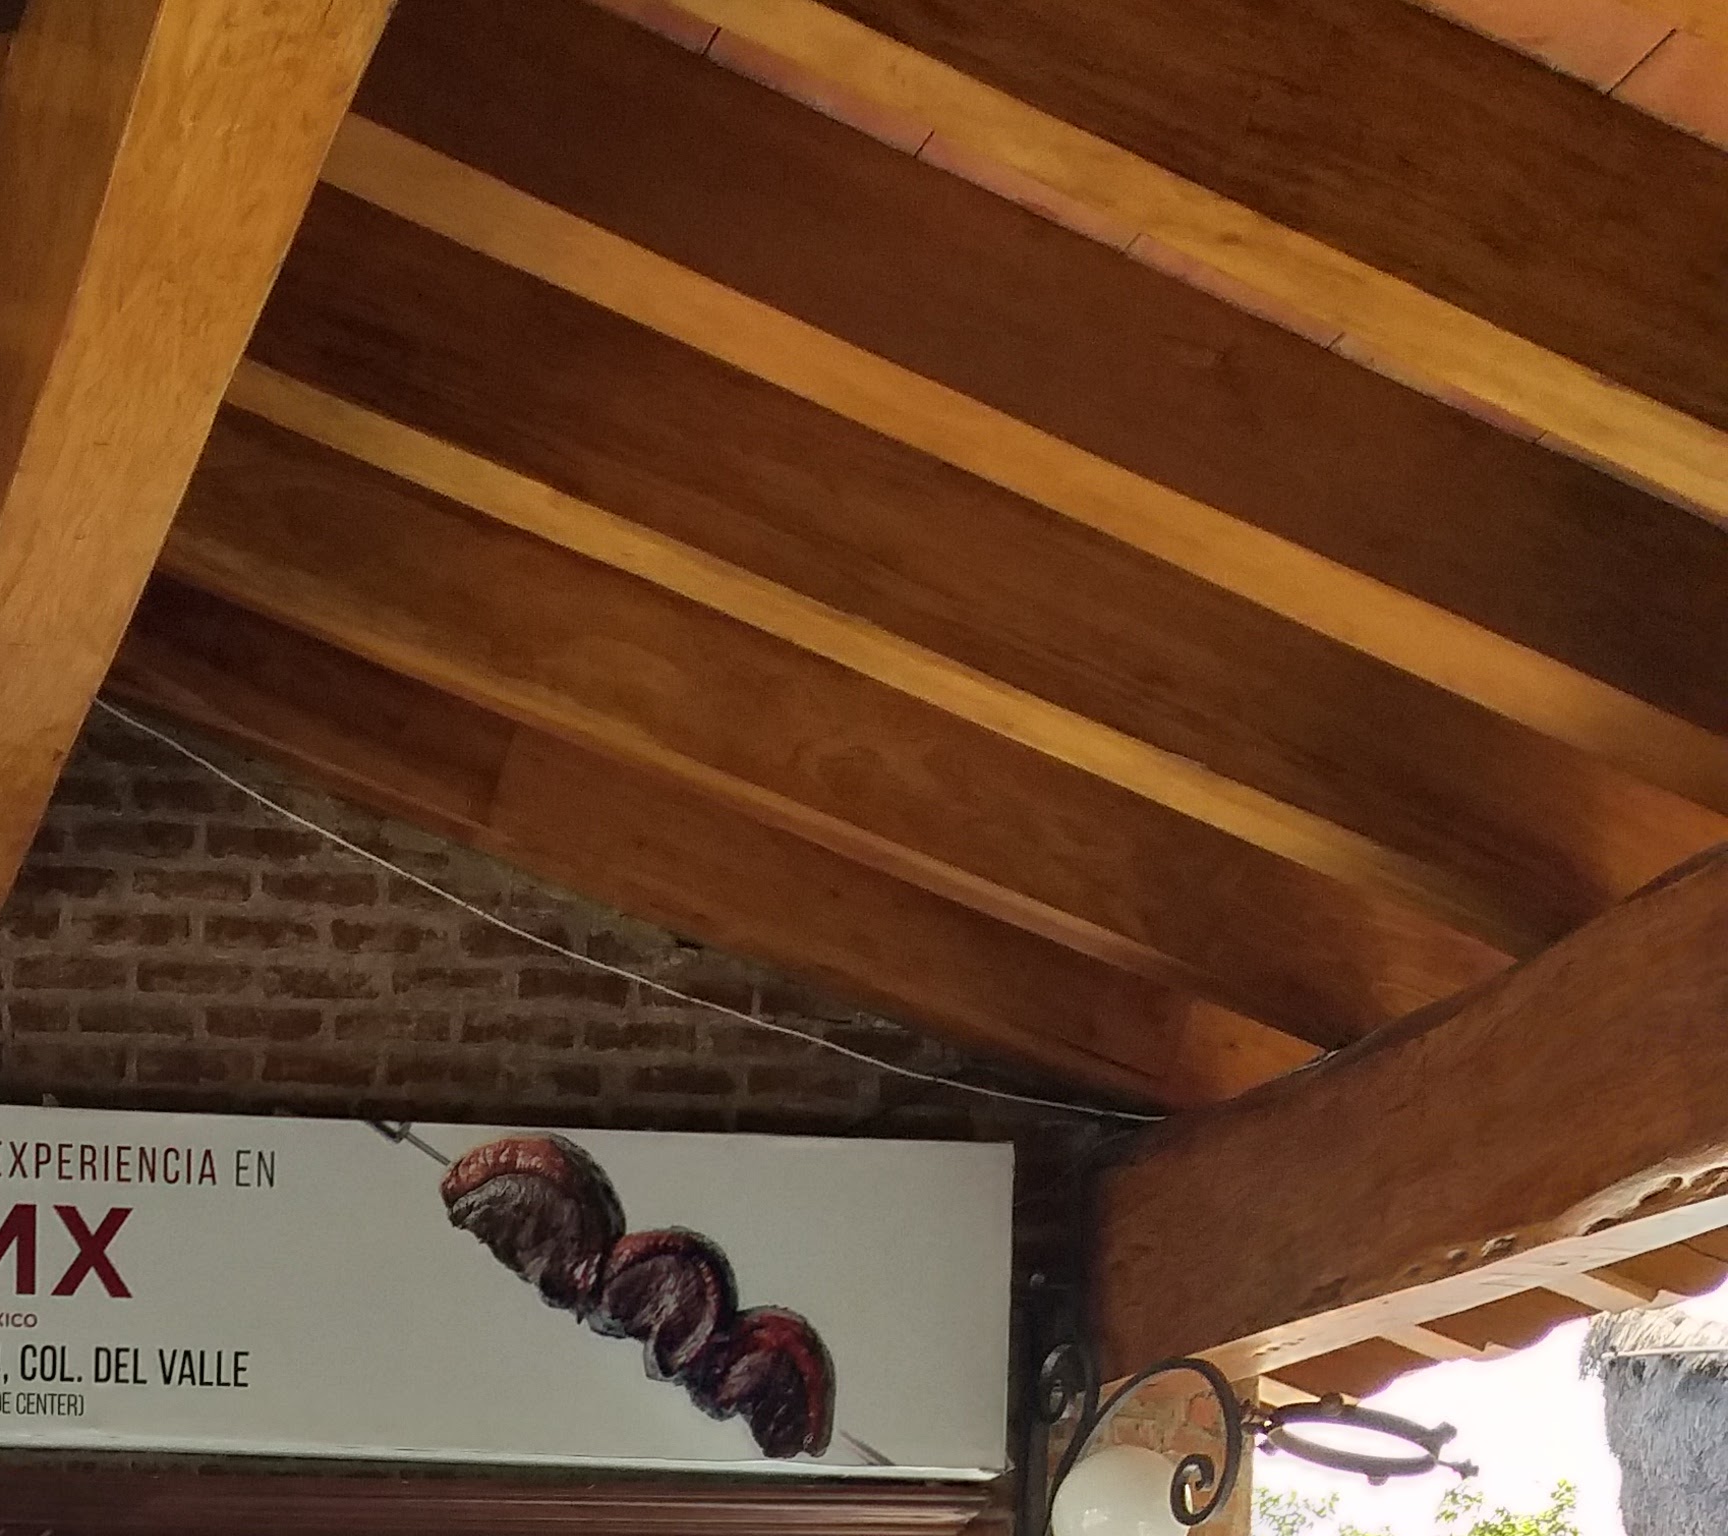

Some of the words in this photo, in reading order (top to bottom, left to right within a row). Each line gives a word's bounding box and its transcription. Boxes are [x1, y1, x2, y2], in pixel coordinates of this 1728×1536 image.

[234, 1149, 276, 1188] EN
[19, 1344, 83, 1383] COL.
[93, 1346, 147, 1385] DEL
[158, 1348, 250, 1388] VALLE
[16, 1392, 85, 1417] CENTER)
